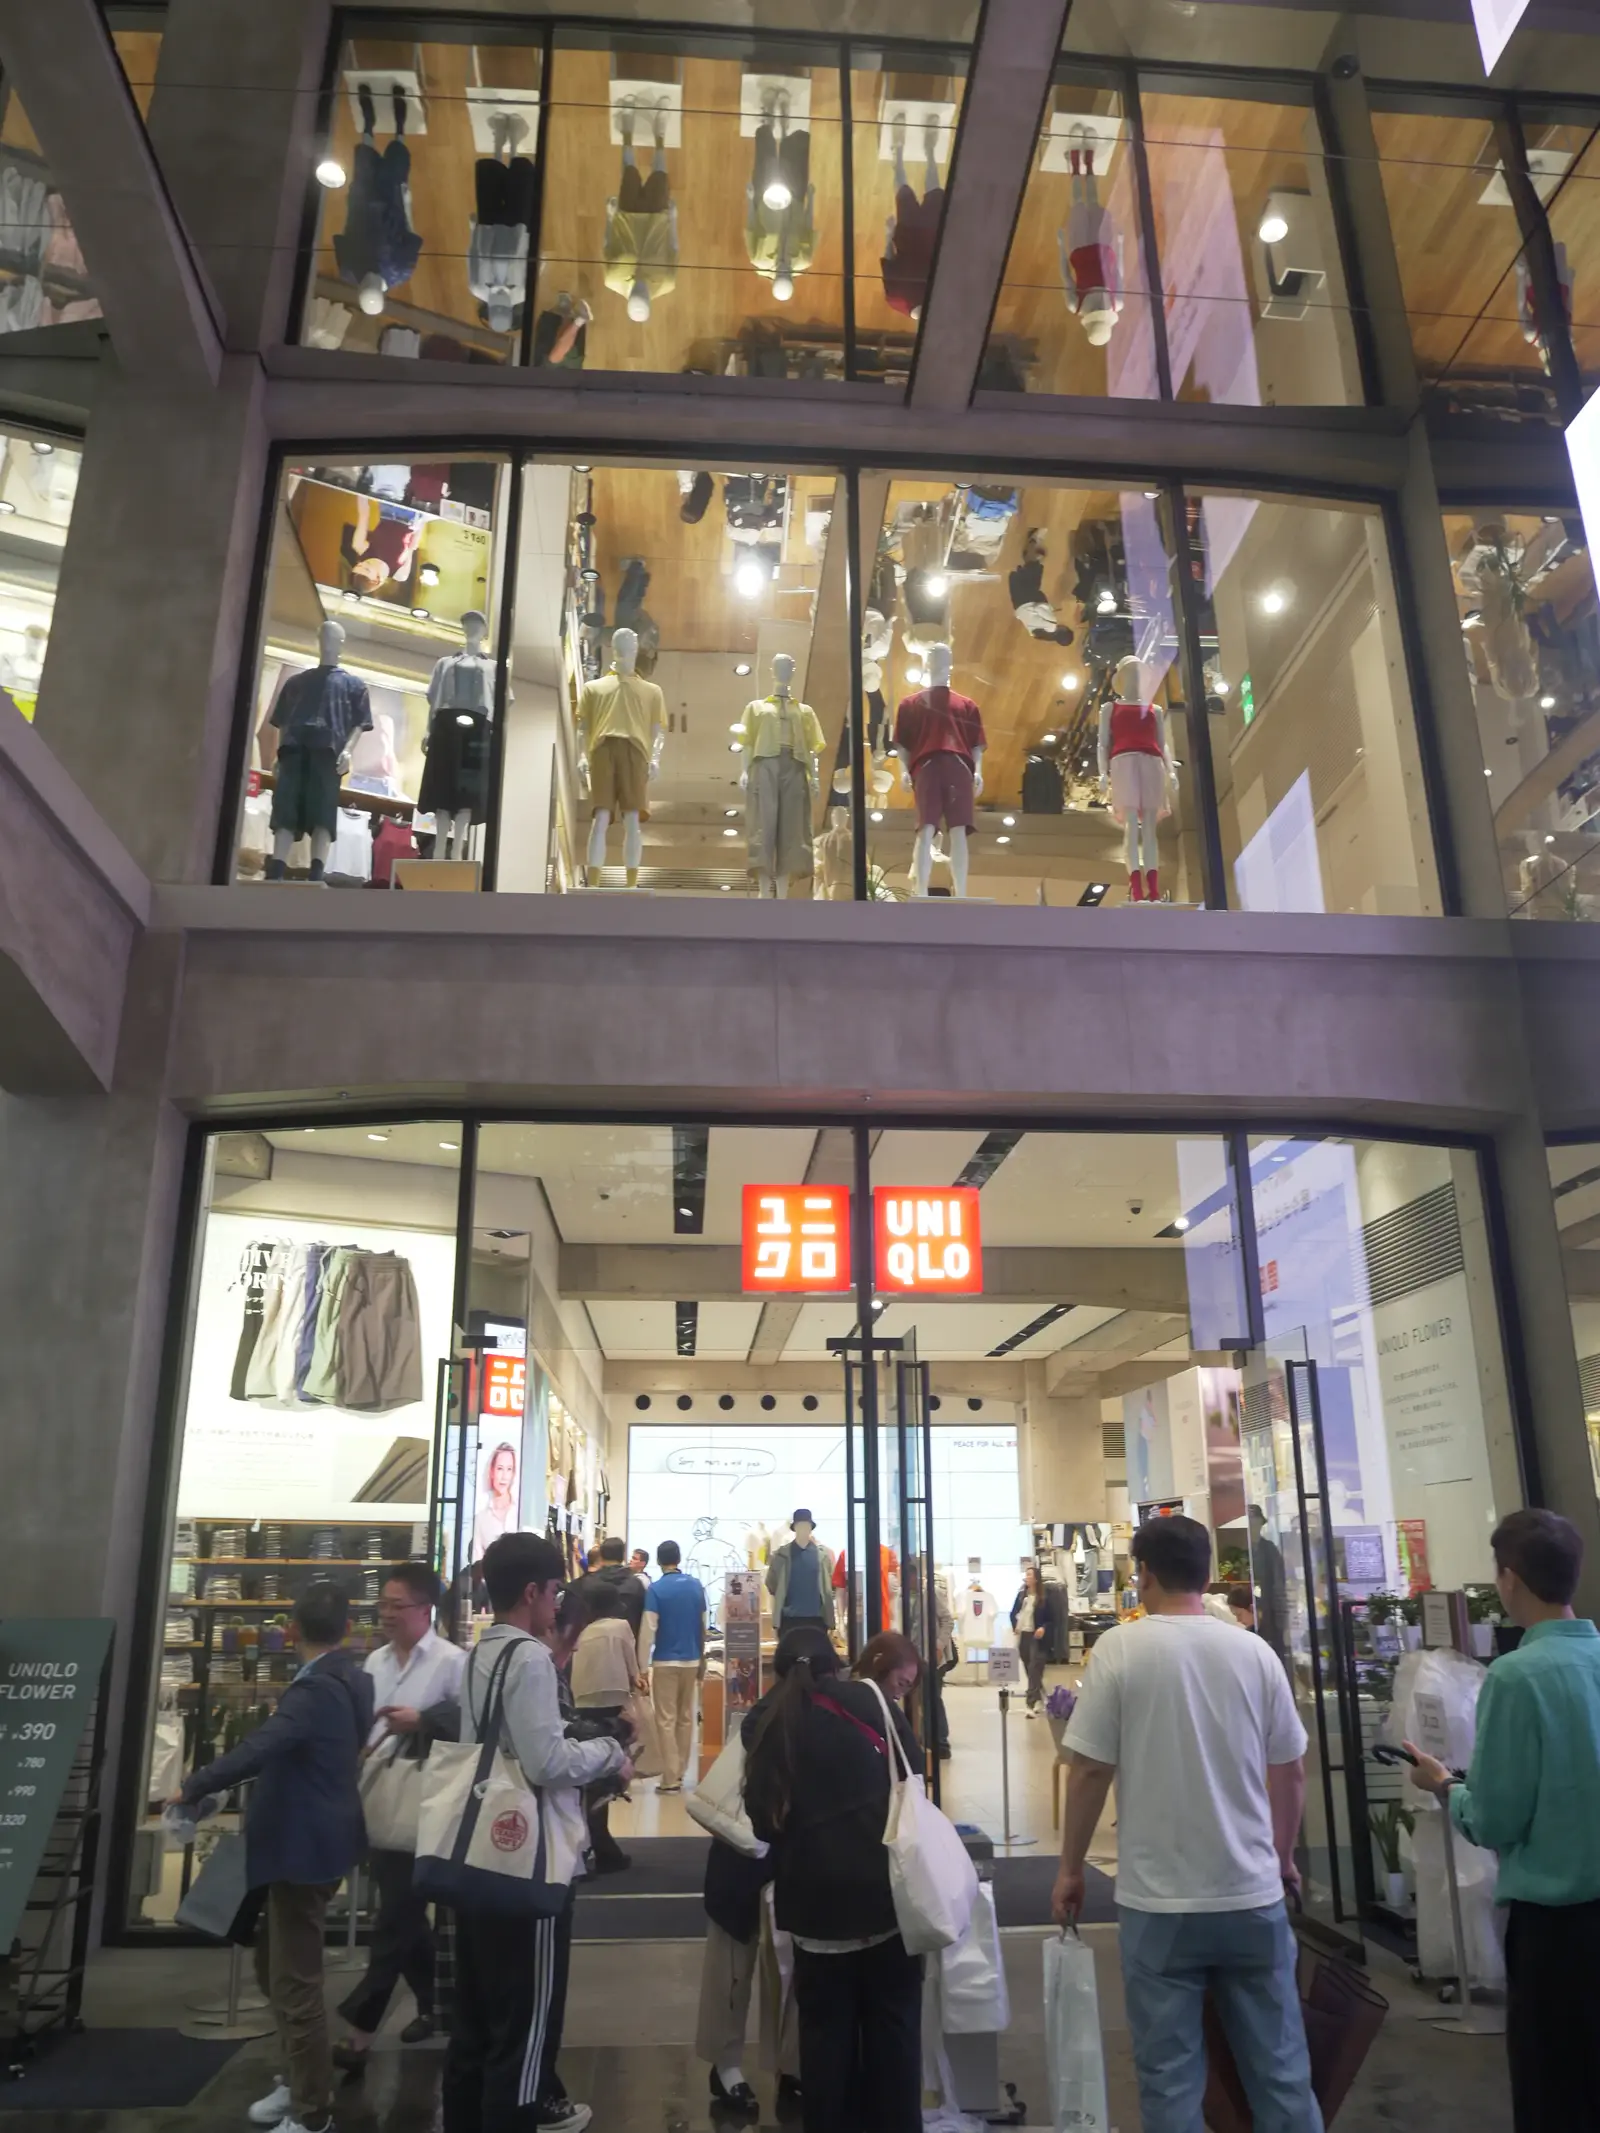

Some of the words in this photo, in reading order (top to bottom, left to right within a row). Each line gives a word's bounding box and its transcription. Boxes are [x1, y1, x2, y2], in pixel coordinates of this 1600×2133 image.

[757, 1198, 836, 1233] ユニ
[886, 1200, 962, 1236] UNI
[754, 1242, 836, 1278] クロ
[887, 1243, 970, 1285] QLO
[8, 1662, 78, 1680] UNIQLO
[0, 1684, 76, 1700] FLOWER
